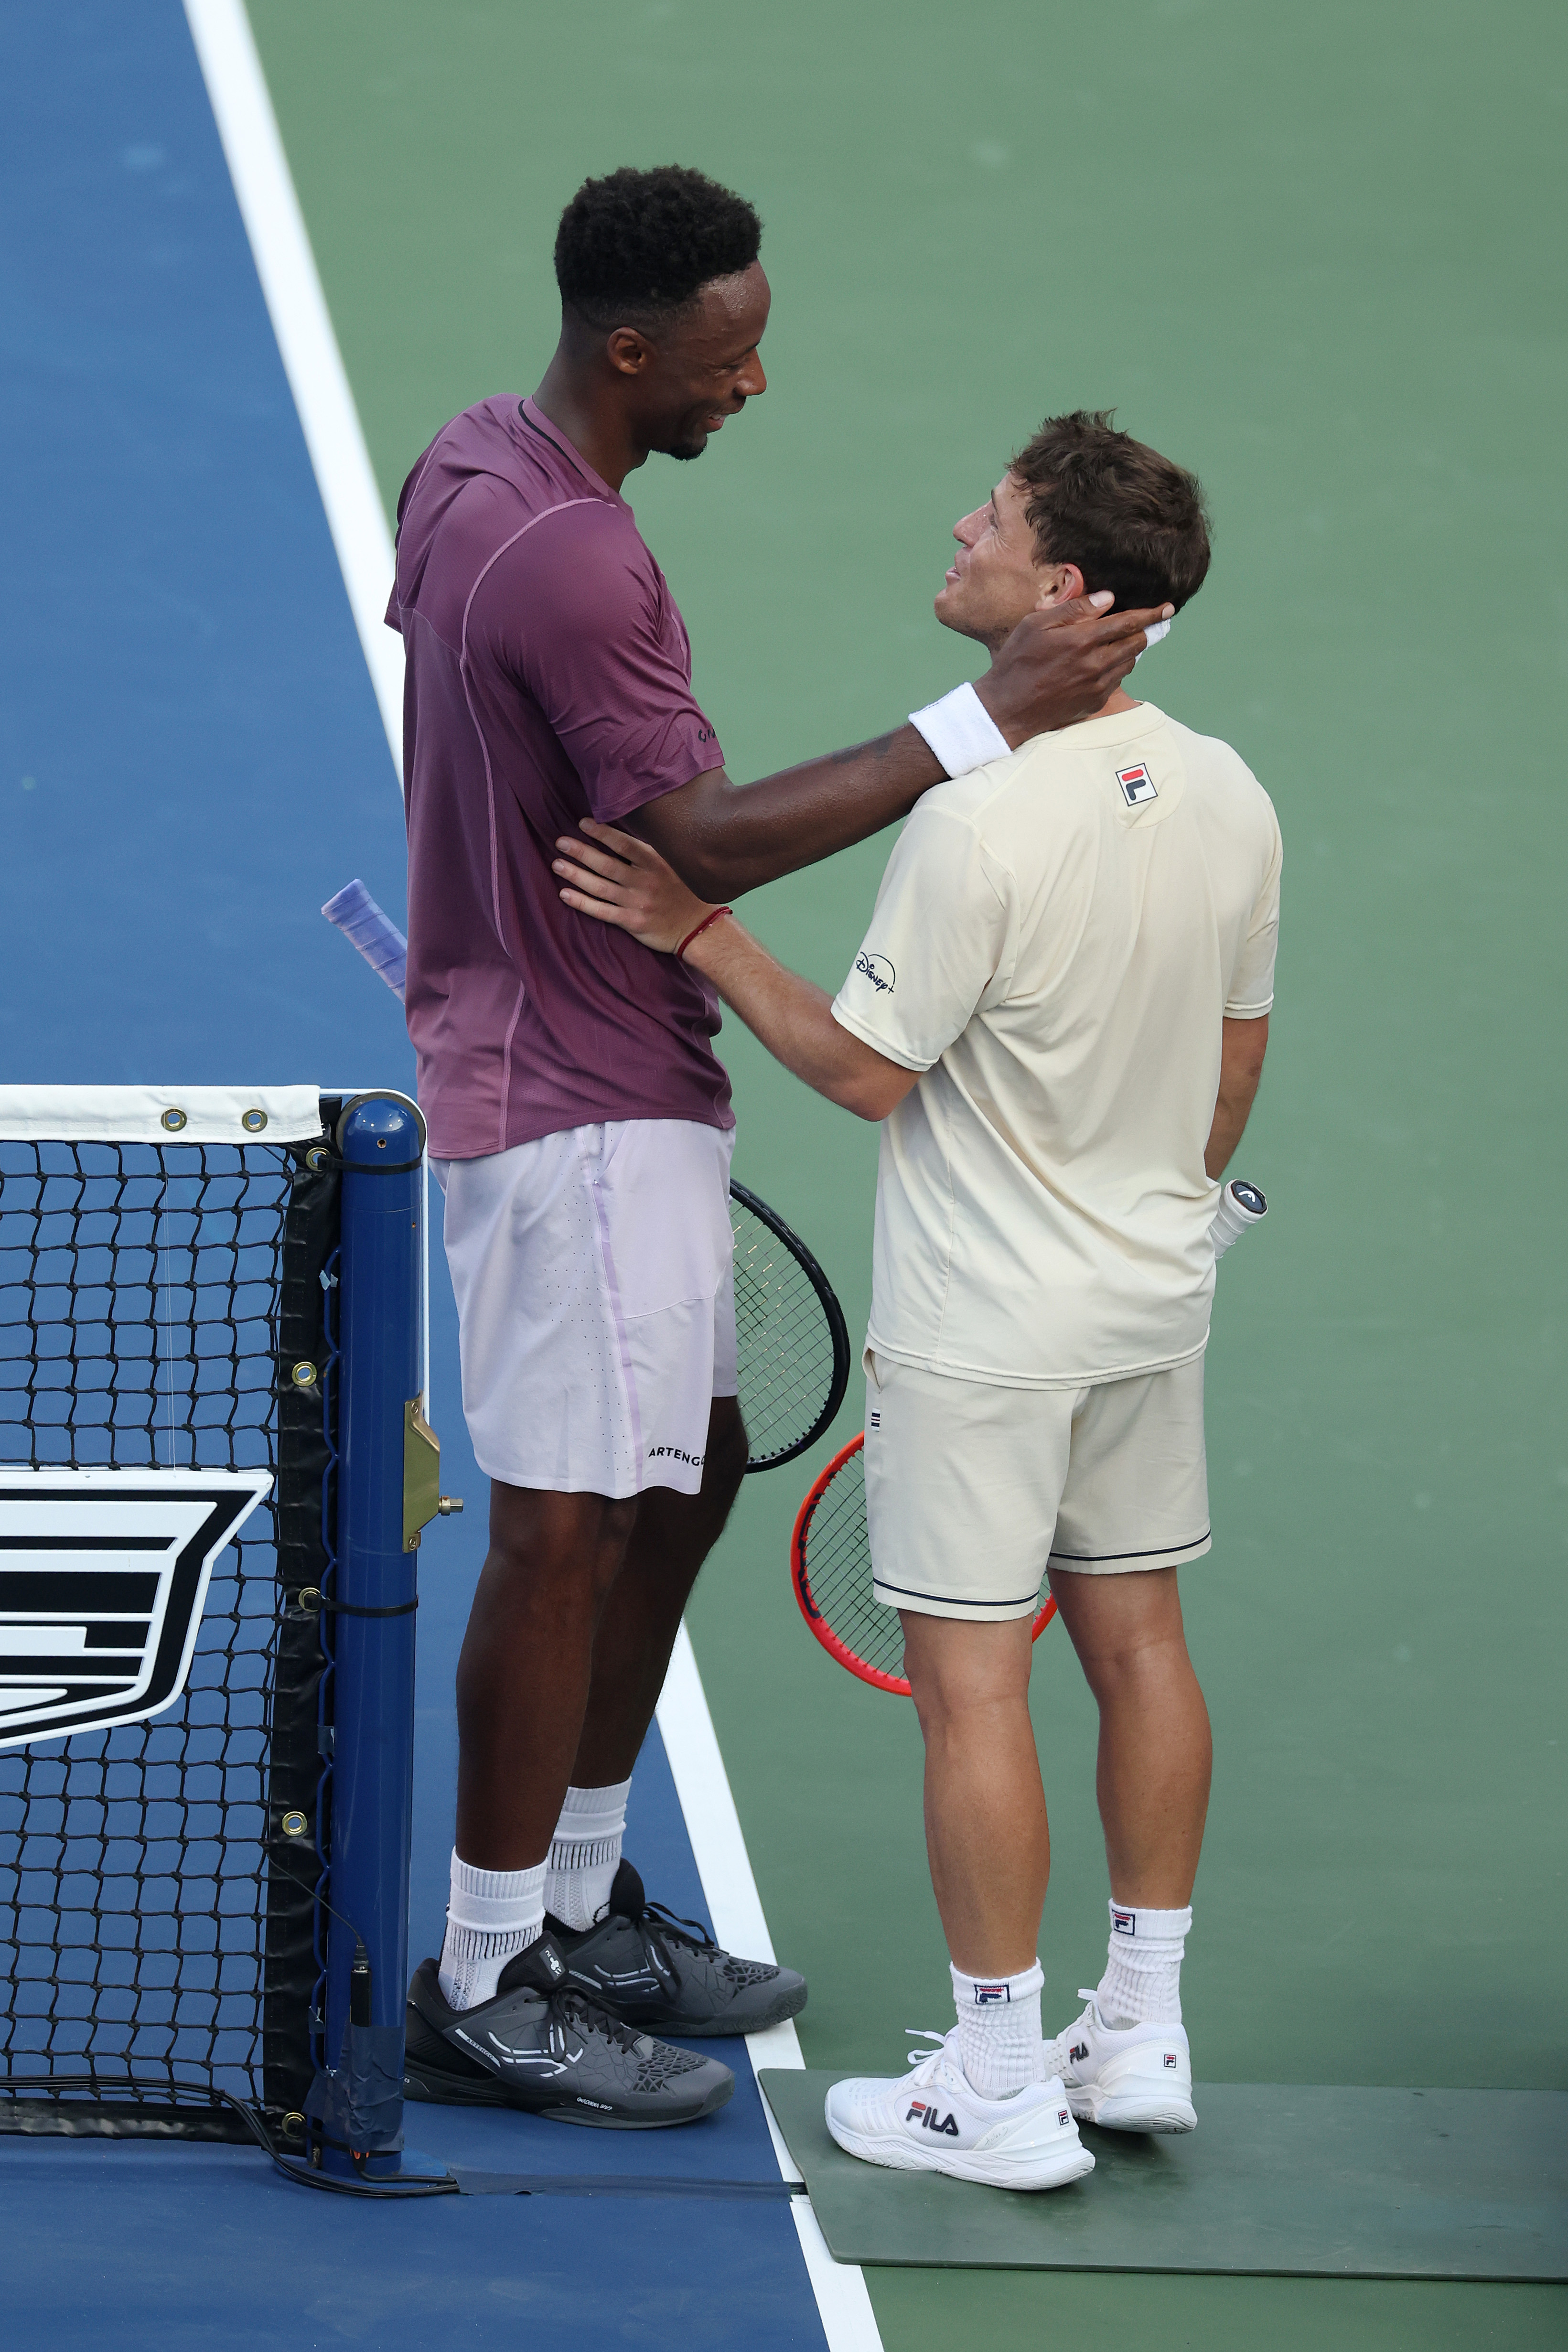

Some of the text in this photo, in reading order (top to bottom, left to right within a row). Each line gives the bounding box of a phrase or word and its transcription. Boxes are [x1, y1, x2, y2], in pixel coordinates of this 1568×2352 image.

[856, 951, 895, 994] Disney+
[466, 2038, 493, 2059] ARTENGO
[906, 2101, 958, 2136] FILA
